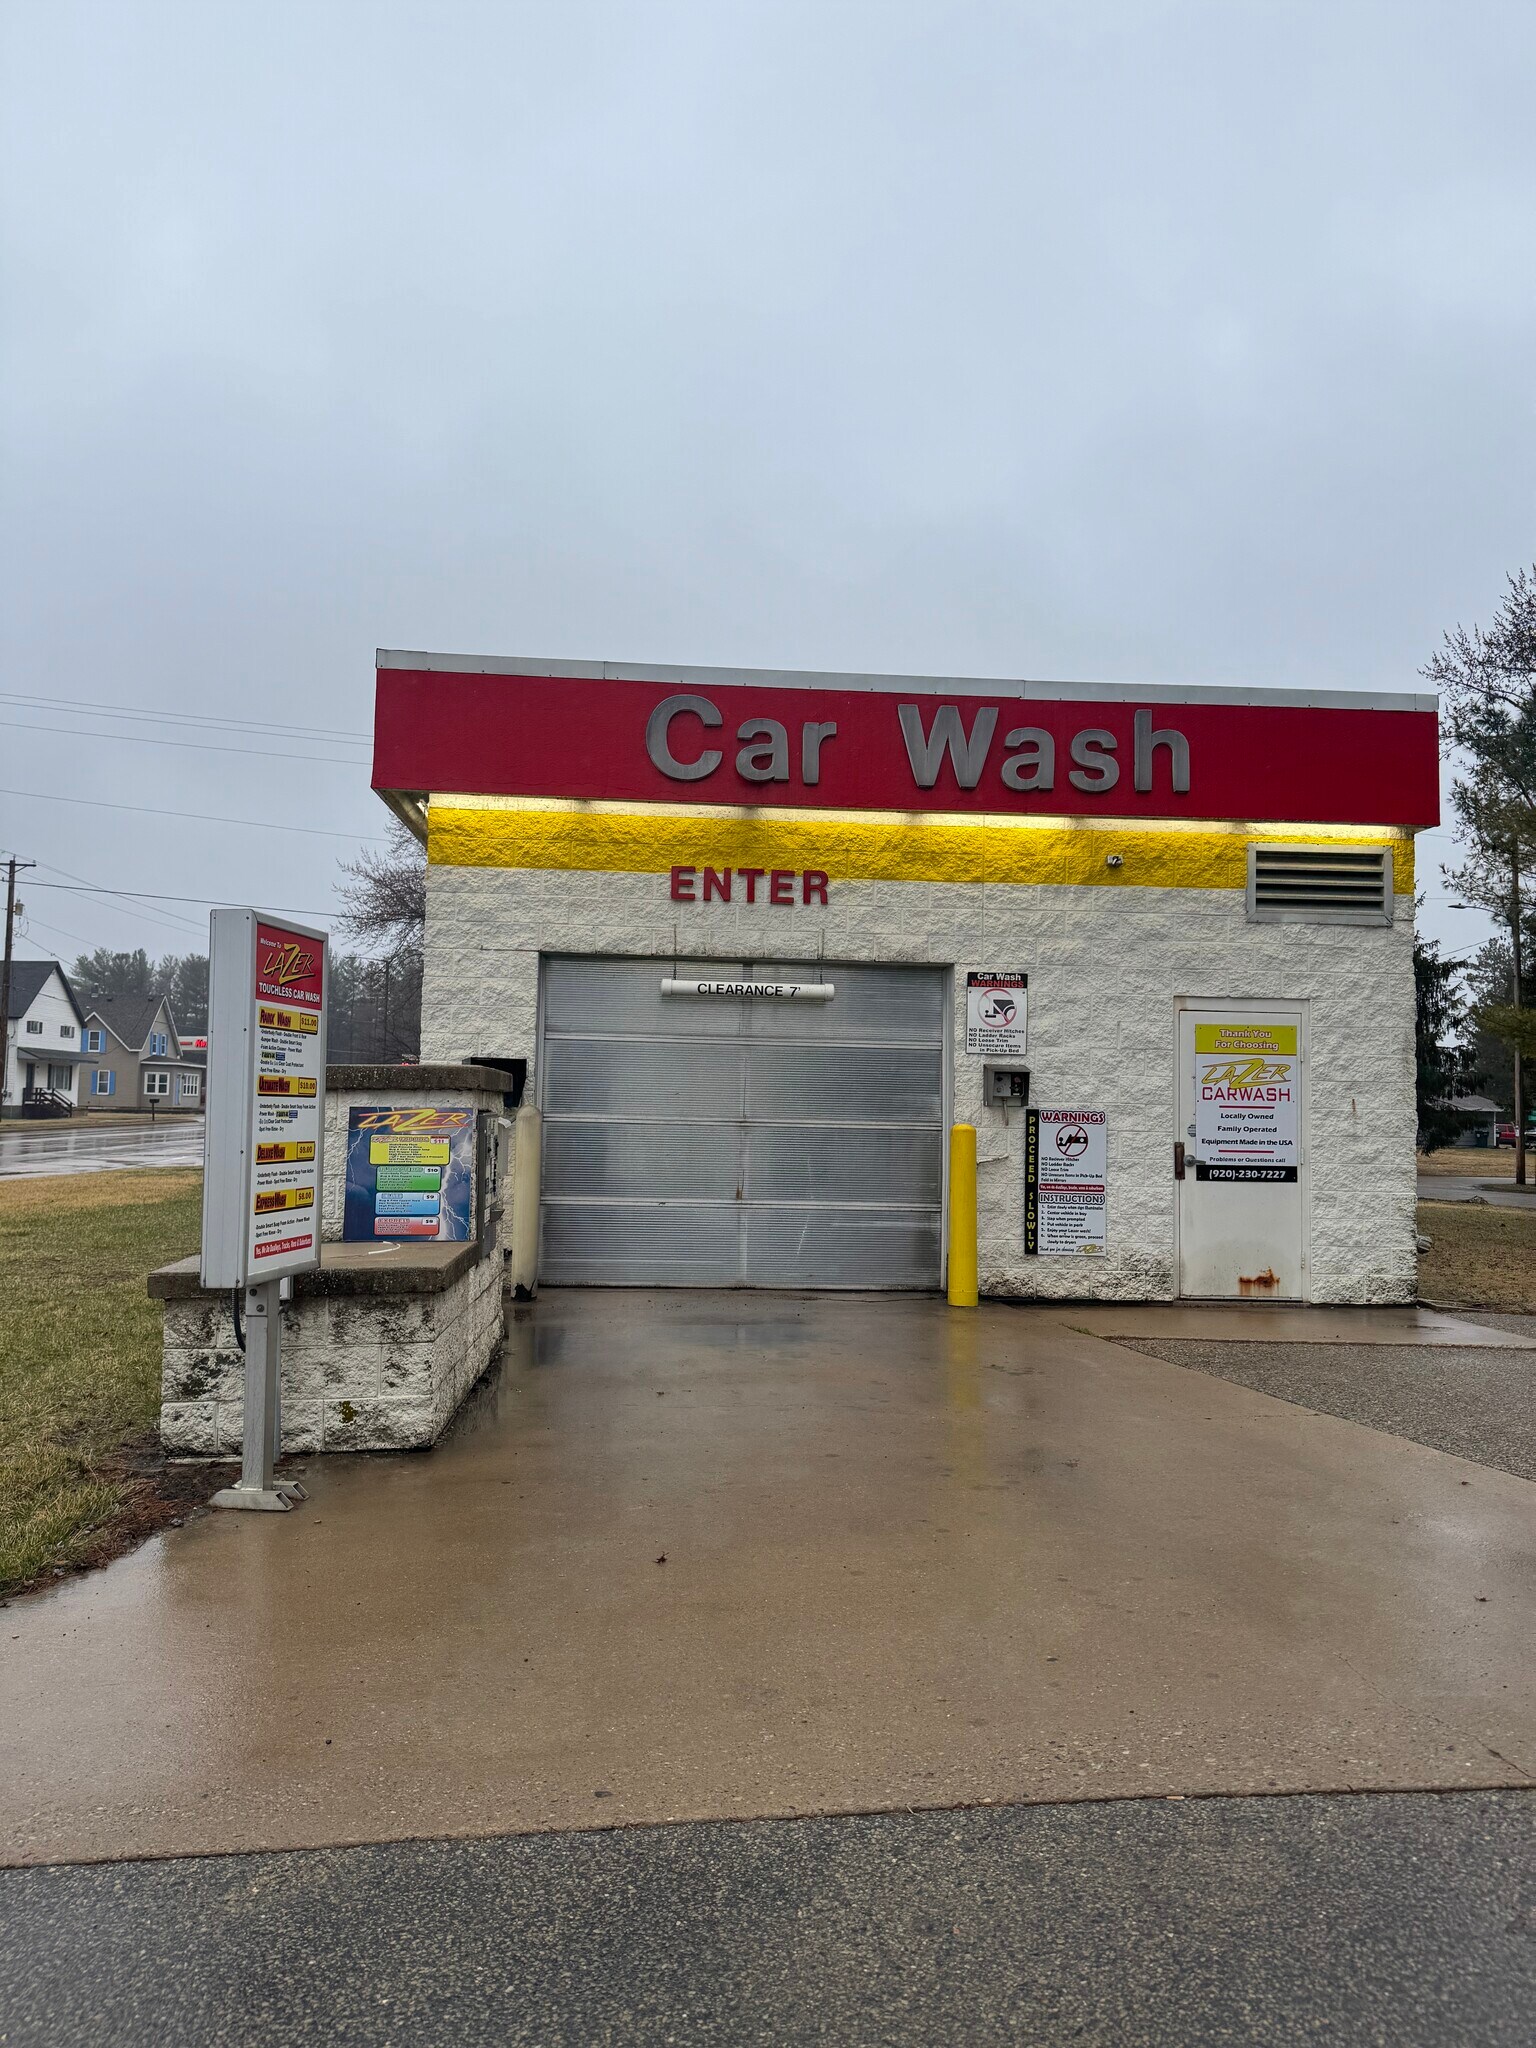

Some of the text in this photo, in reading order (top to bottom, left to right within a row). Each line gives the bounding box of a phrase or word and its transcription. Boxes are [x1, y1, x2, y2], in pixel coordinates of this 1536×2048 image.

[645, 694, 1191, 794] Car Wash
[670, 865, 829, 905] ENTER
[263, 943, 315, 985] LAZER
[996, 973, 1022, 981] Wash
[697, 983, 784, 996] CLEARANCE
[971, 980, 1024, 988] WARNINGS
[258, 982, 320, 1002] TOUCHLESS CAR WASH
[301, 1018, 316, 1026] $11.00
[1220, 1028, 1271, 1038] Thank You
[1234, 1041, 1279, 1052] Choosing
[1202, 1058, 1292, 1089] LAZER
[300, 1081, 315, 1090] $10.00
[1202, 1087, 1290, 1101] CARWASH
[358, 1108, 468, 1132] LAZER
[1041, 1111, 1104, 1123] WARNINGS
[1027, 1116, 1036, 1183] PROCEED
[1209, 1170, 1286, 1180] (920)-230-7227
[1040, 1194, 1104, 1203] INSTRUCTIONS
[1026, 1192, 1036, 1250] SLOWLY
